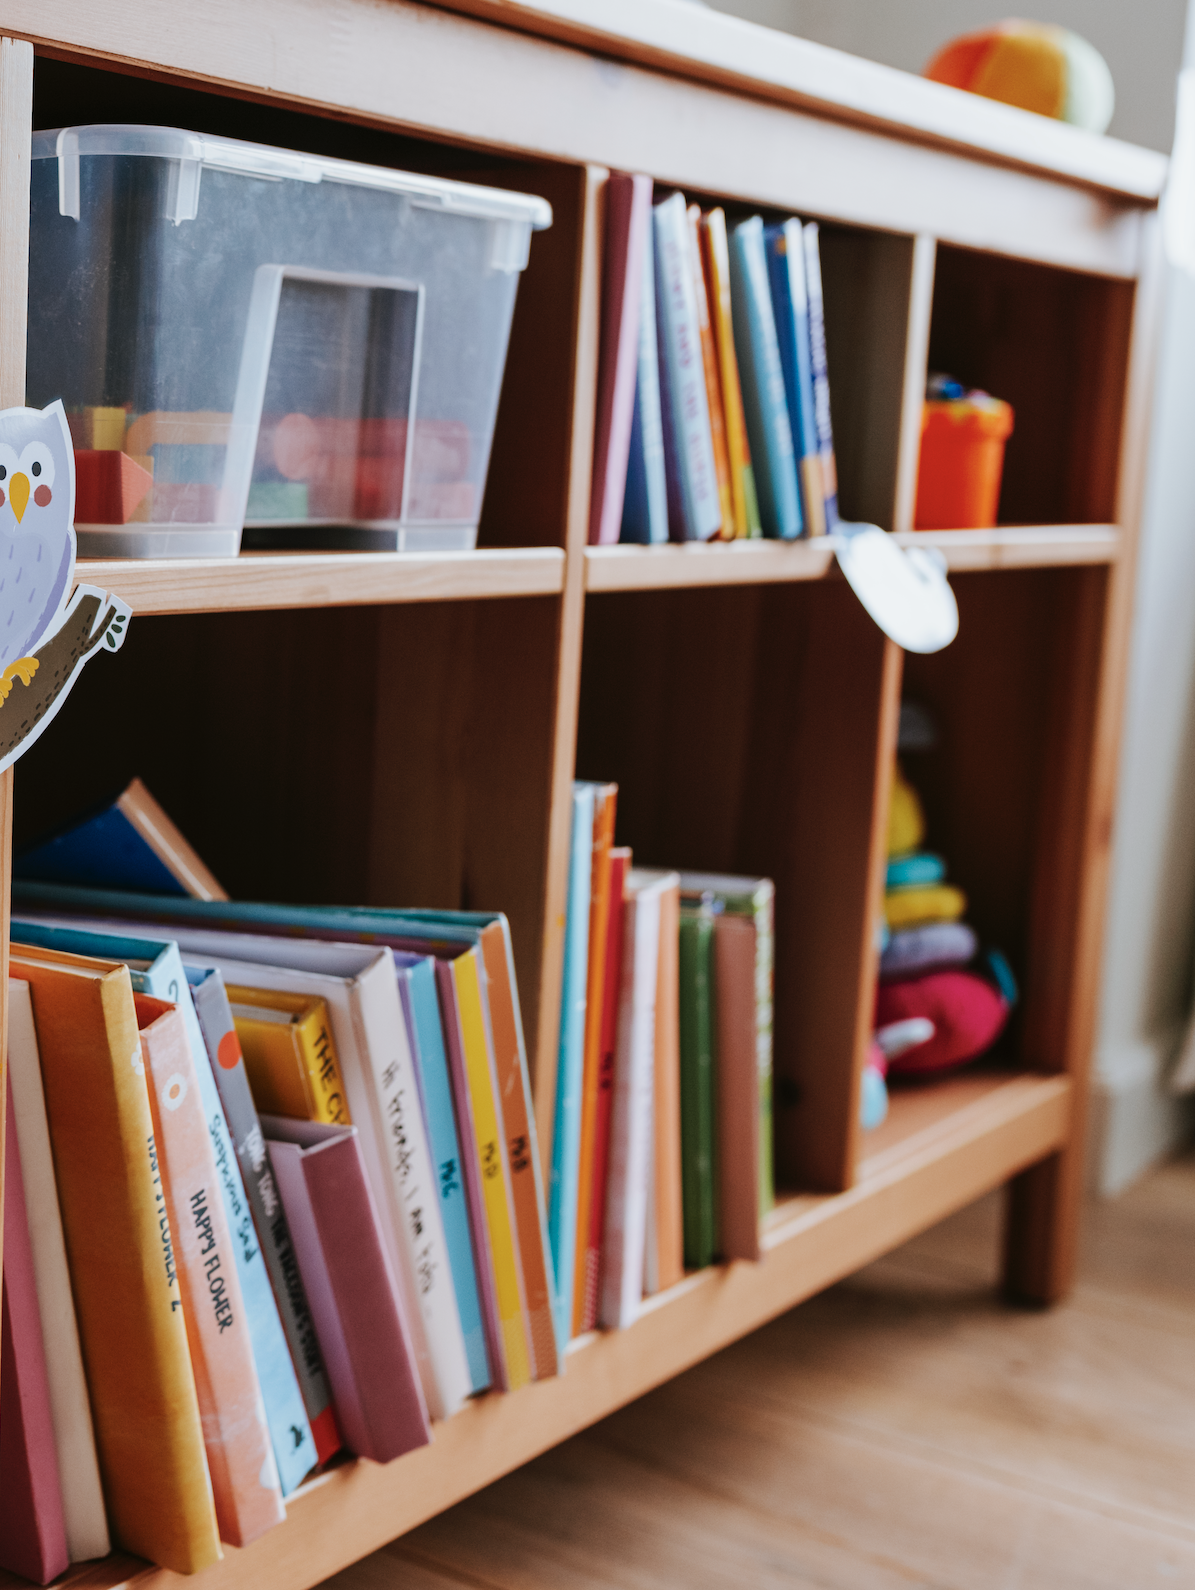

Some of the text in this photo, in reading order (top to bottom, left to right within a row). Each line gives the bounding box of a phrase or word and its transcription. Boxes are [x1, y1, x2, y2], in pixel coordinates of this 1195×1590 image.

[312, 1025, 337, 1092] THE
[189, 1188, 234, 1335] HAPPY FLOWER
